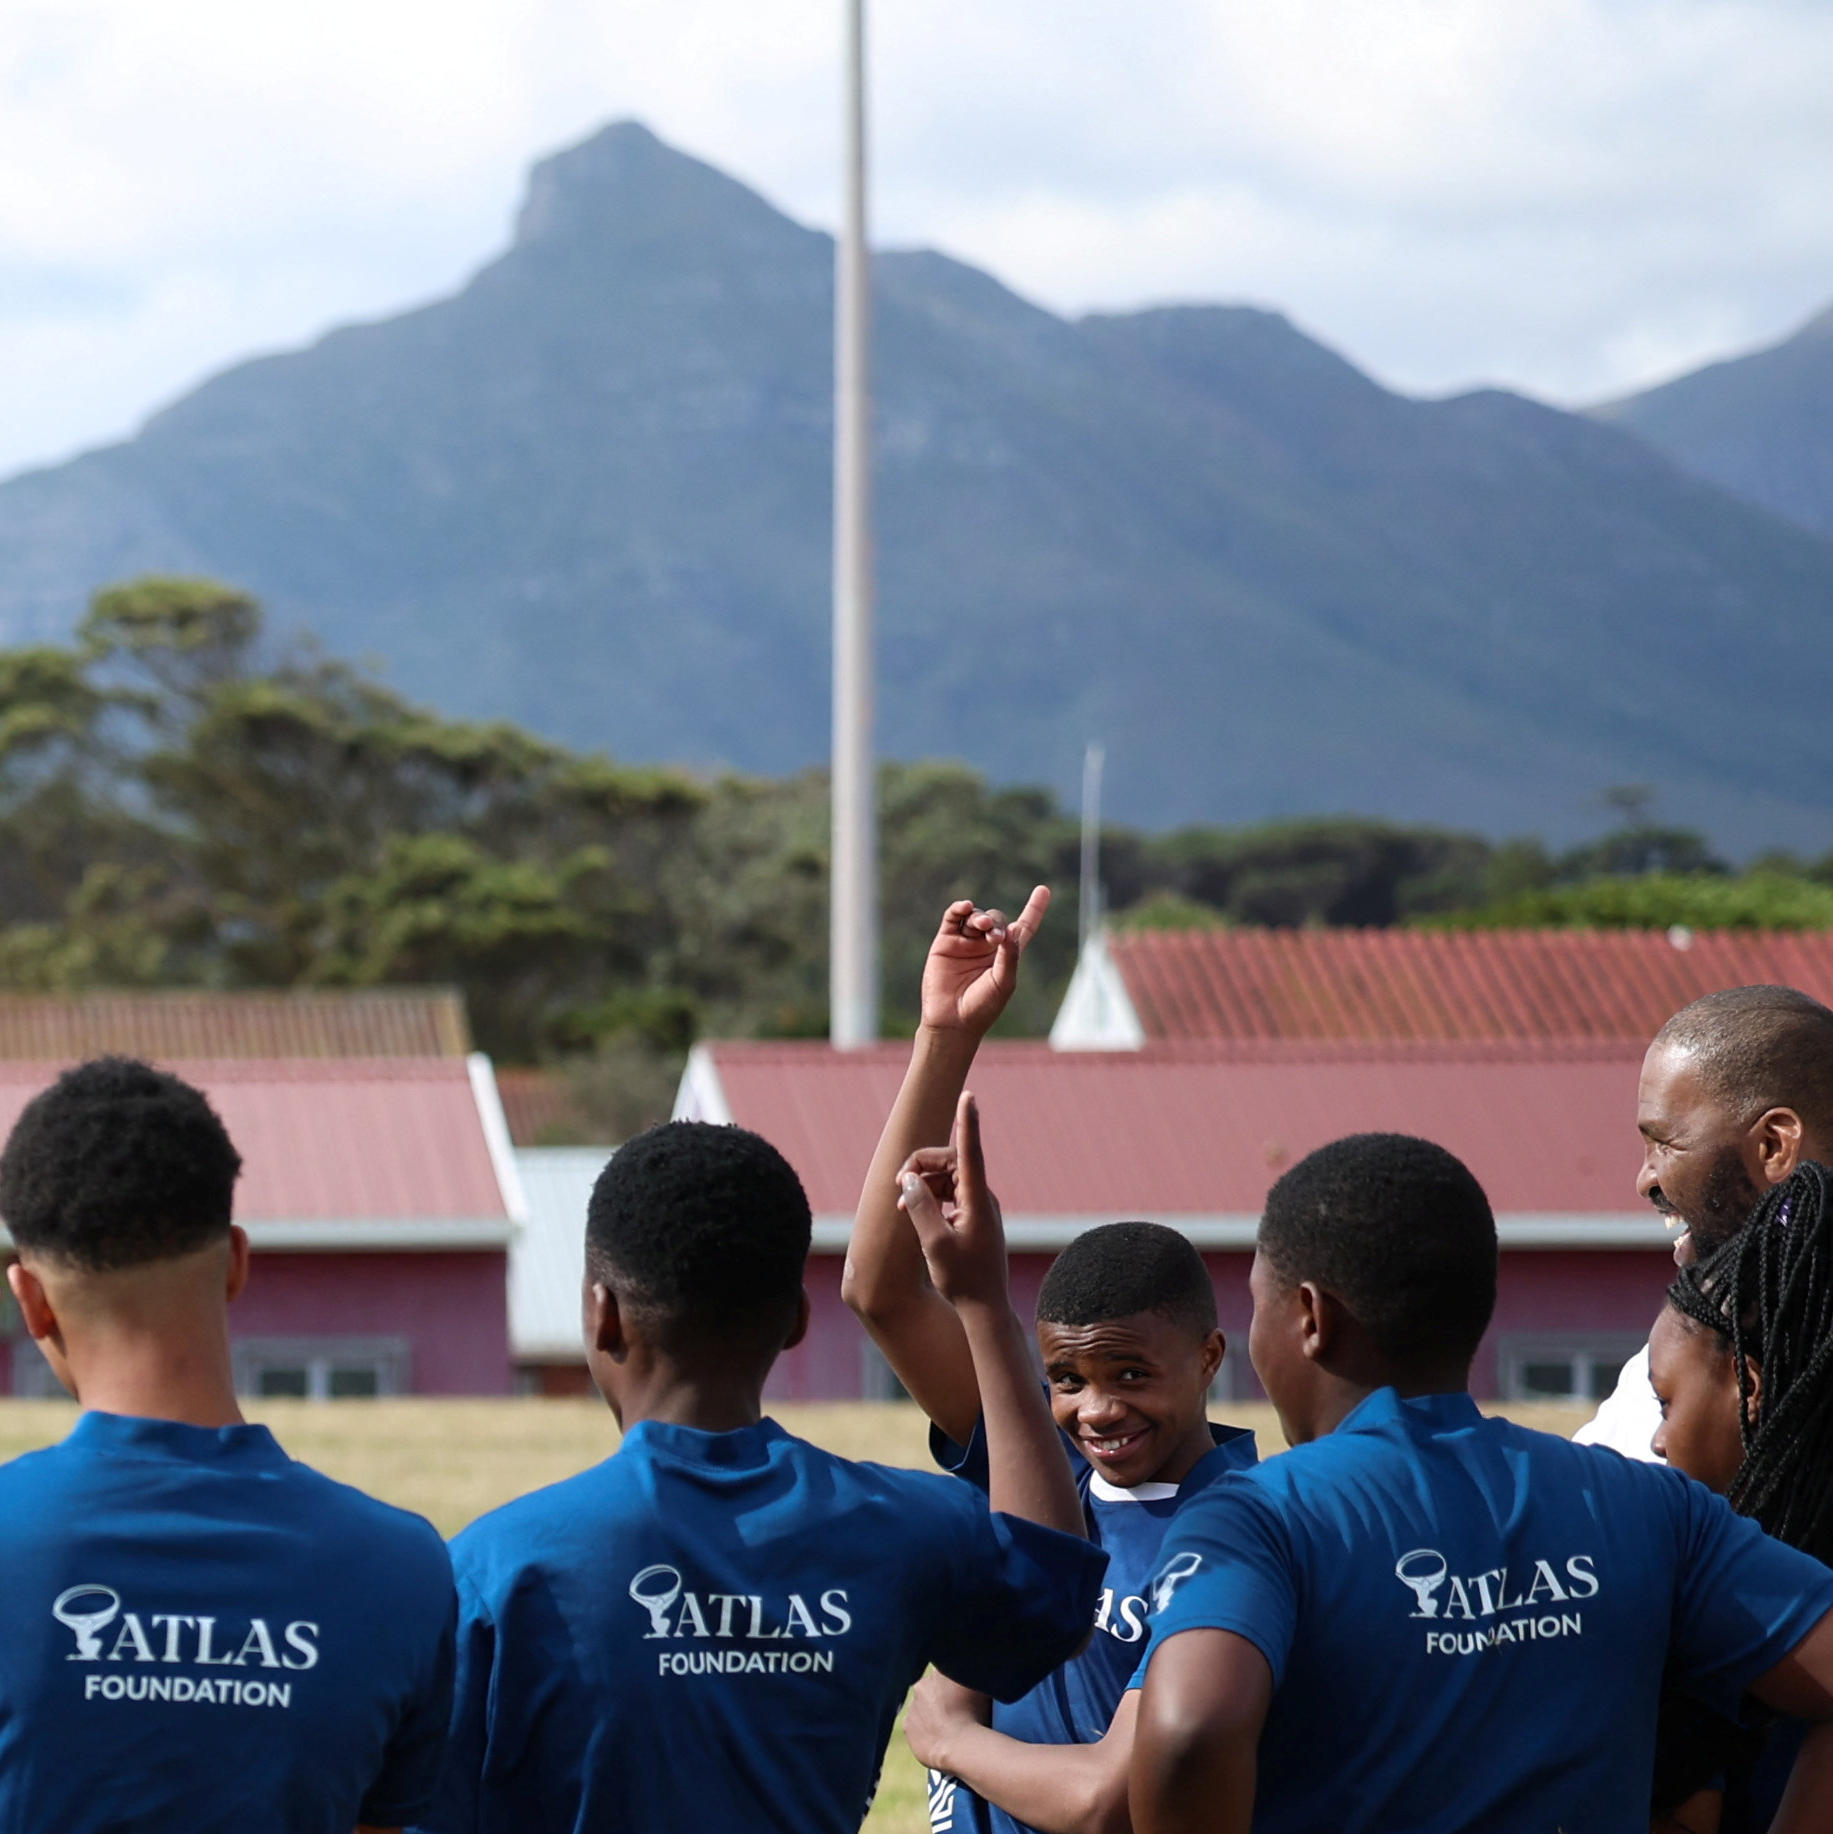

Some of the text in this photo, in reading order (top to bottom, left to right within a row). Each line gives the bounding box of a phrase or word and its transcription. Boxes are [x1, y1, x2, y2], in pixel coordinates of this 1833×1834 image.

[1443, 1555, 1599, 1620] ATLAS
[673, 1590, 851, 1639] ATLAS
[106, 1613, 320, 1669] ATLAS
[659, 1651, 833, 1676] FOUNDATION
[85, 1675, 290, 1708] FOUNDATION
